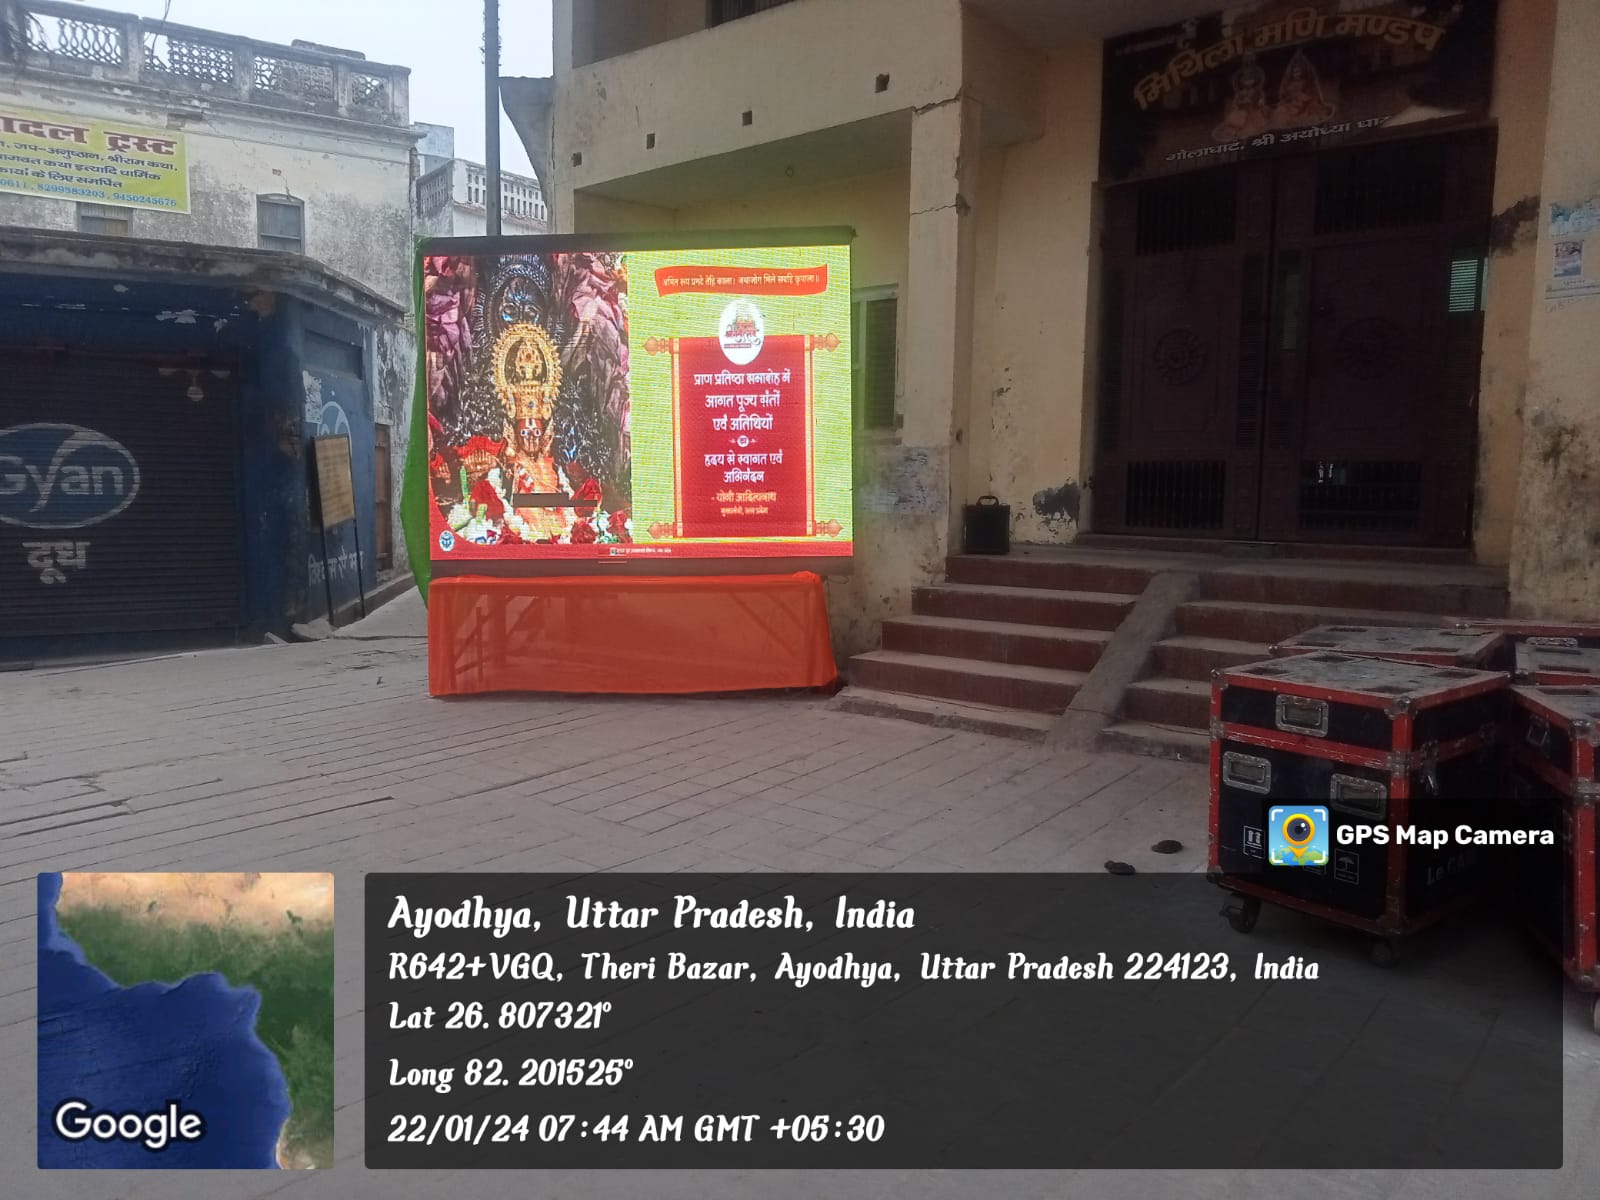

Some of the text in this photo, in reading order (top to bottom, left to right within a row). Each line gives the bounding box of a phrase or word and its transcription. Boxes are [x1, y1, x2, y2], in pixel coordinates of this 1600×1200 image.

[1134, 33, 1244, 110] मिथिला
[1254, 8, 1326, 48] मणि
[1335, 13, 1446, 50] मण्डप
[0, 117, 178, 156] ादल ट्रस्ट
[1251, 132, 1275, 148] श्री
[1279, 122, 1350, 143] अयोध्या
[43, 159, 72, 170] कथा
[74, 162, 118, 175] इत्यादि
[107, 153, 145, 167] श्रीराम
[31, 167, 47, 179] के
[48, 171, 74, 183] लिए
[693, 368, 791, 386] प्राण प्रतिष्ठा समारोह में
[705, 394, 734, 408] आगत
[736, 394, 758, 413] पूज्य
[712, 413, 774, 431] एवं अतिथियों
[726, 449, 736, 465] से
[737, 453, 768, 466] स्वागत
[769, 448, 783, 464] एवं
[0, 453, 124, 513] Gyan
[723, 467, 765, 483] अभिनंदन
[22, 541, 91, 585] दूध
